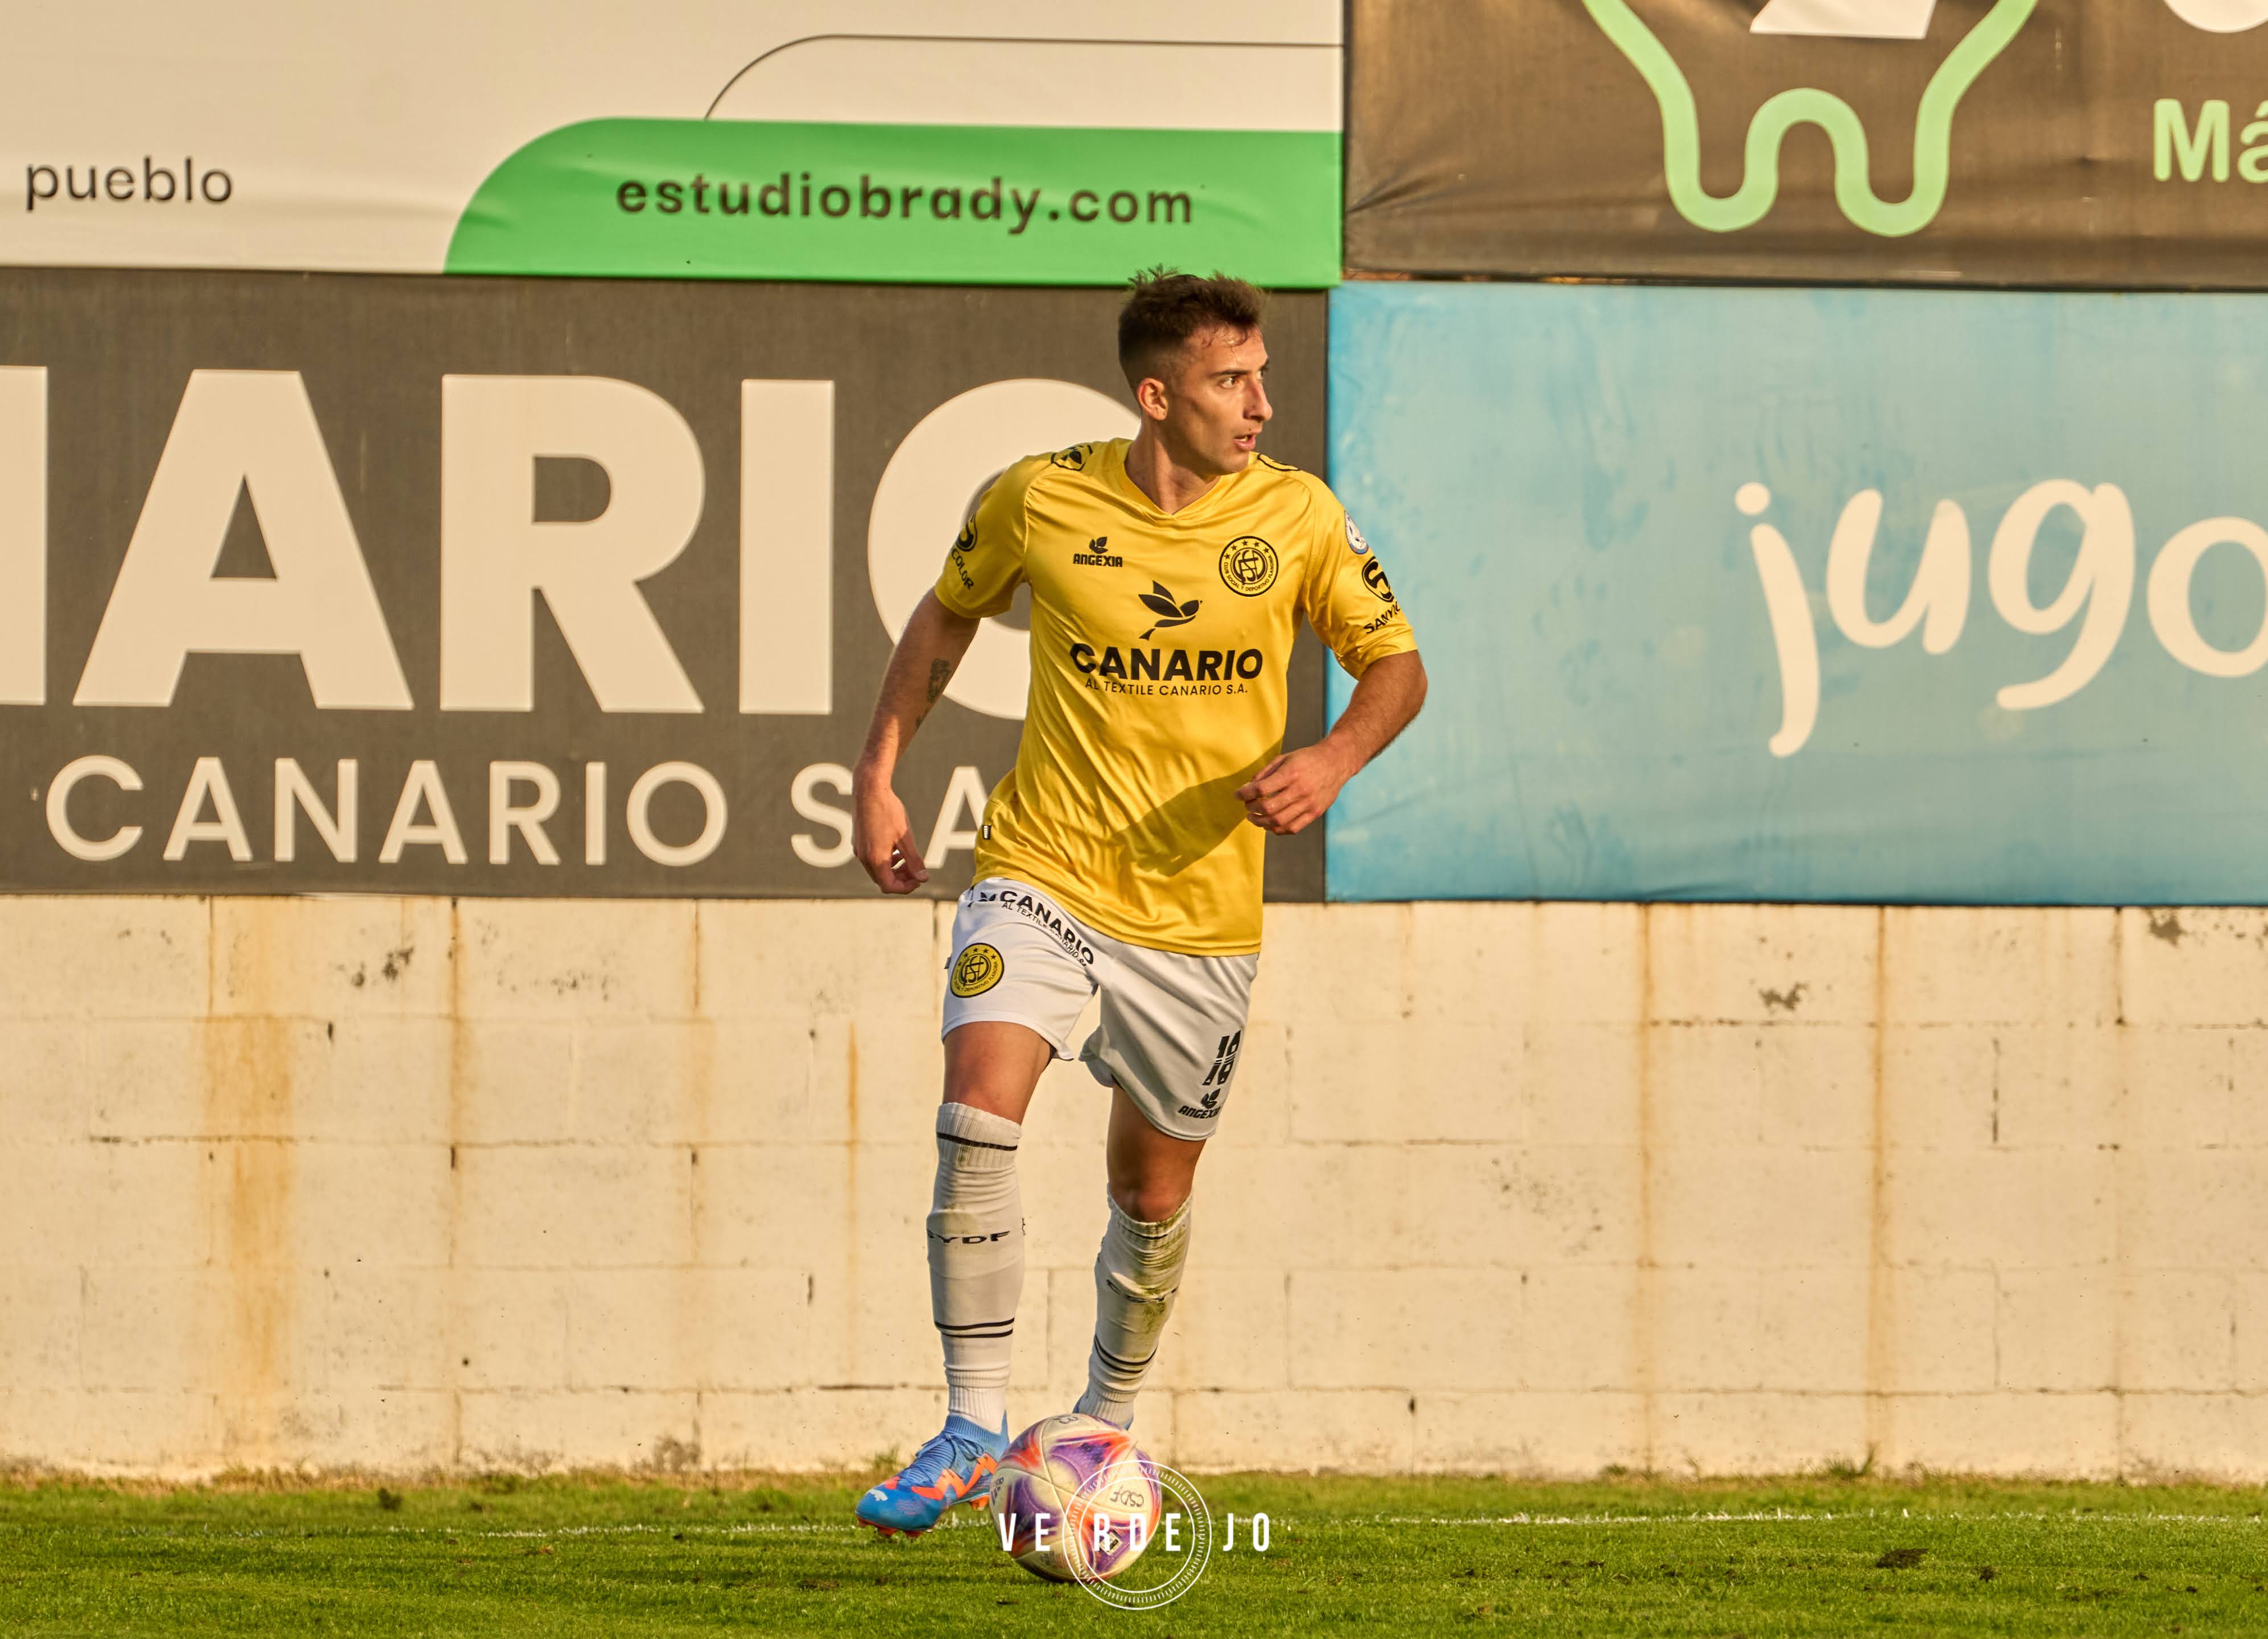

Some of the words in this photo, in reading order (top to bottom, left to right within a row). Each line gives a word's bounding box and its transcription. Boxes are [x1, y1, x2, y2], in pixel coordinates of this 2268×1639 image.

[26, 155, 233, 213] pueblo
[617, 172, 1192, 234] estudiobrady.com
[1073, 553, 1123, 568] ANGEXIA
[1069, 643, 1263, 682] CANARIO
[1085, 678, 1098, 690] AL
[1104, 681, 1153, 696] TEXTILE
[1159, 684, 1222, 696] CANARIO
[1226, 683, 1248, 695] S.A.
[46, 755, 728, 866] CANARIO
[1000, 891, 1093, 965] CANARIO
